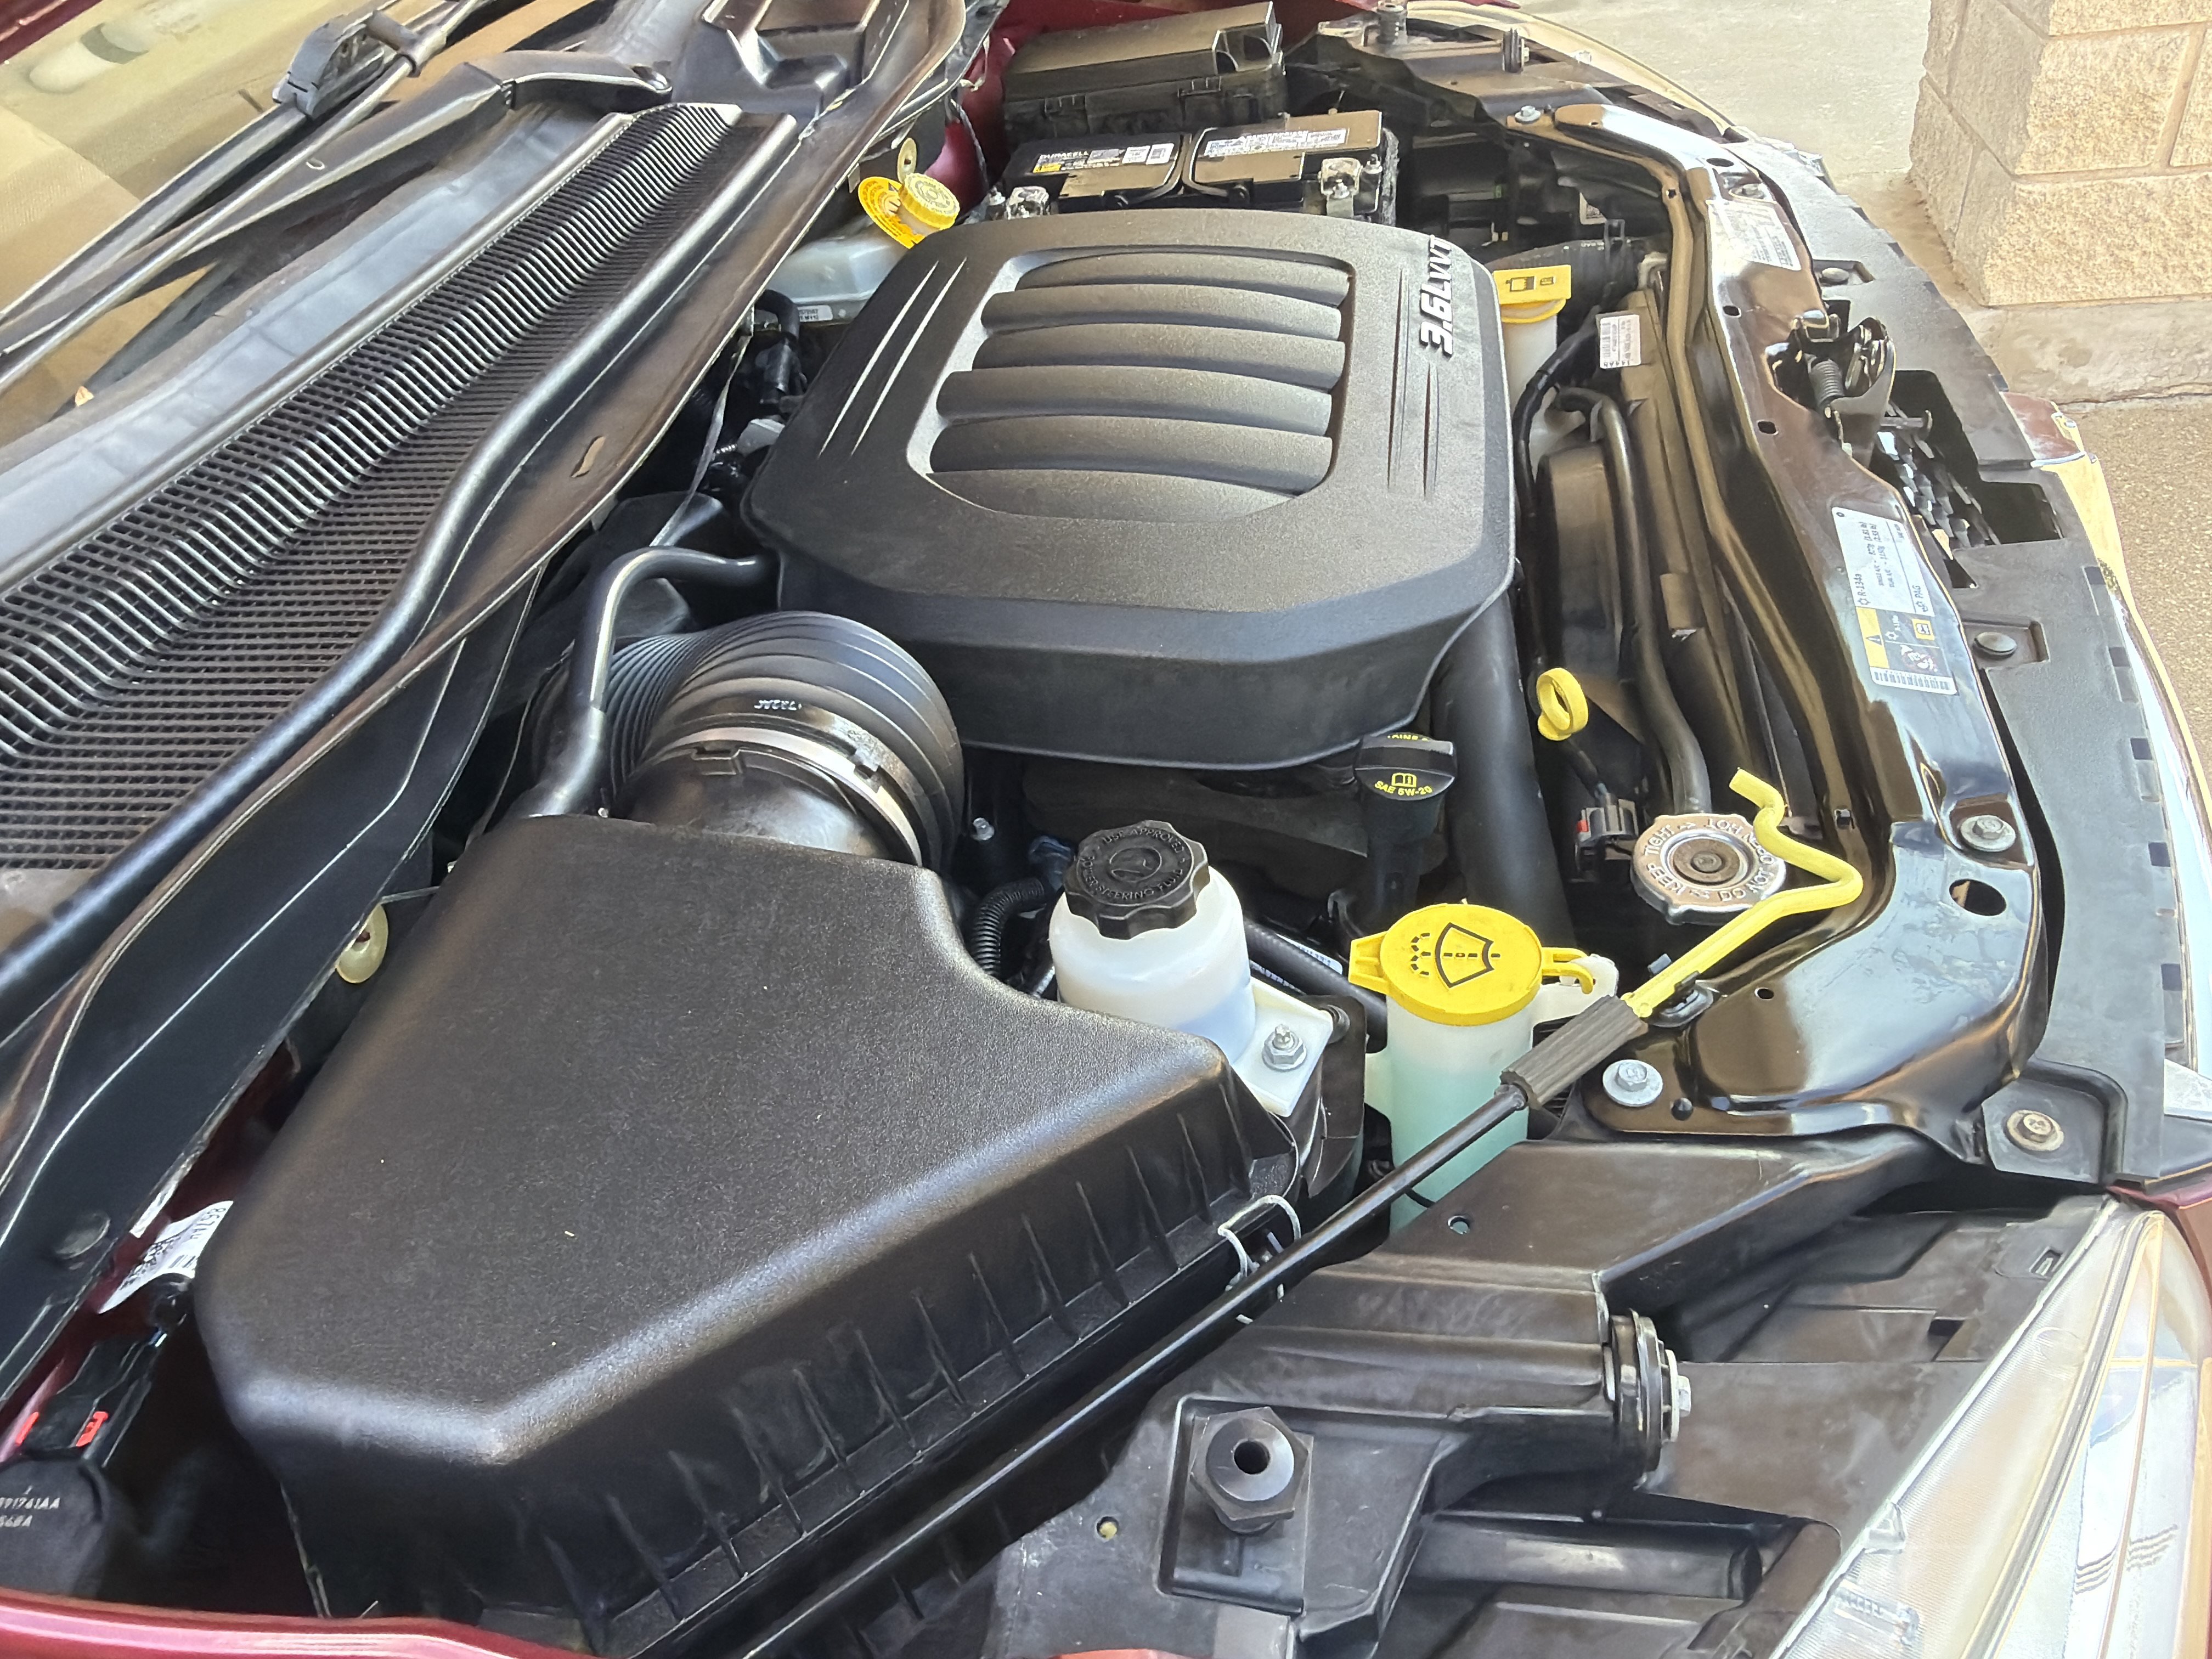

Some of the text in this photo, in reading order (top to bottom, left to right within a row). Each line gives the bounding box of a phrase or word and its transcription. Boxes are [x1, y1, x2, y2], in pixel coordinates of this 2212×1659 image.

[1420, 234, 1453, 355] 3.6L VVT
[1854, 573, 1867, 597] R-134a
[1912, 584, 1924, 599] PAG
[1374, 781, 1396, 794] SAE
[1707, 818, 1743, 834] HOT
[1102, 827, 1185, 854] USE APPROVED
[1644, 824, 1686, 895] KEEP TIGHT
[1745, 867, 1775, 893] NOT
[1096, 884, 1155, 900] STEERING
[1718, 888, 1746, 901] DO
